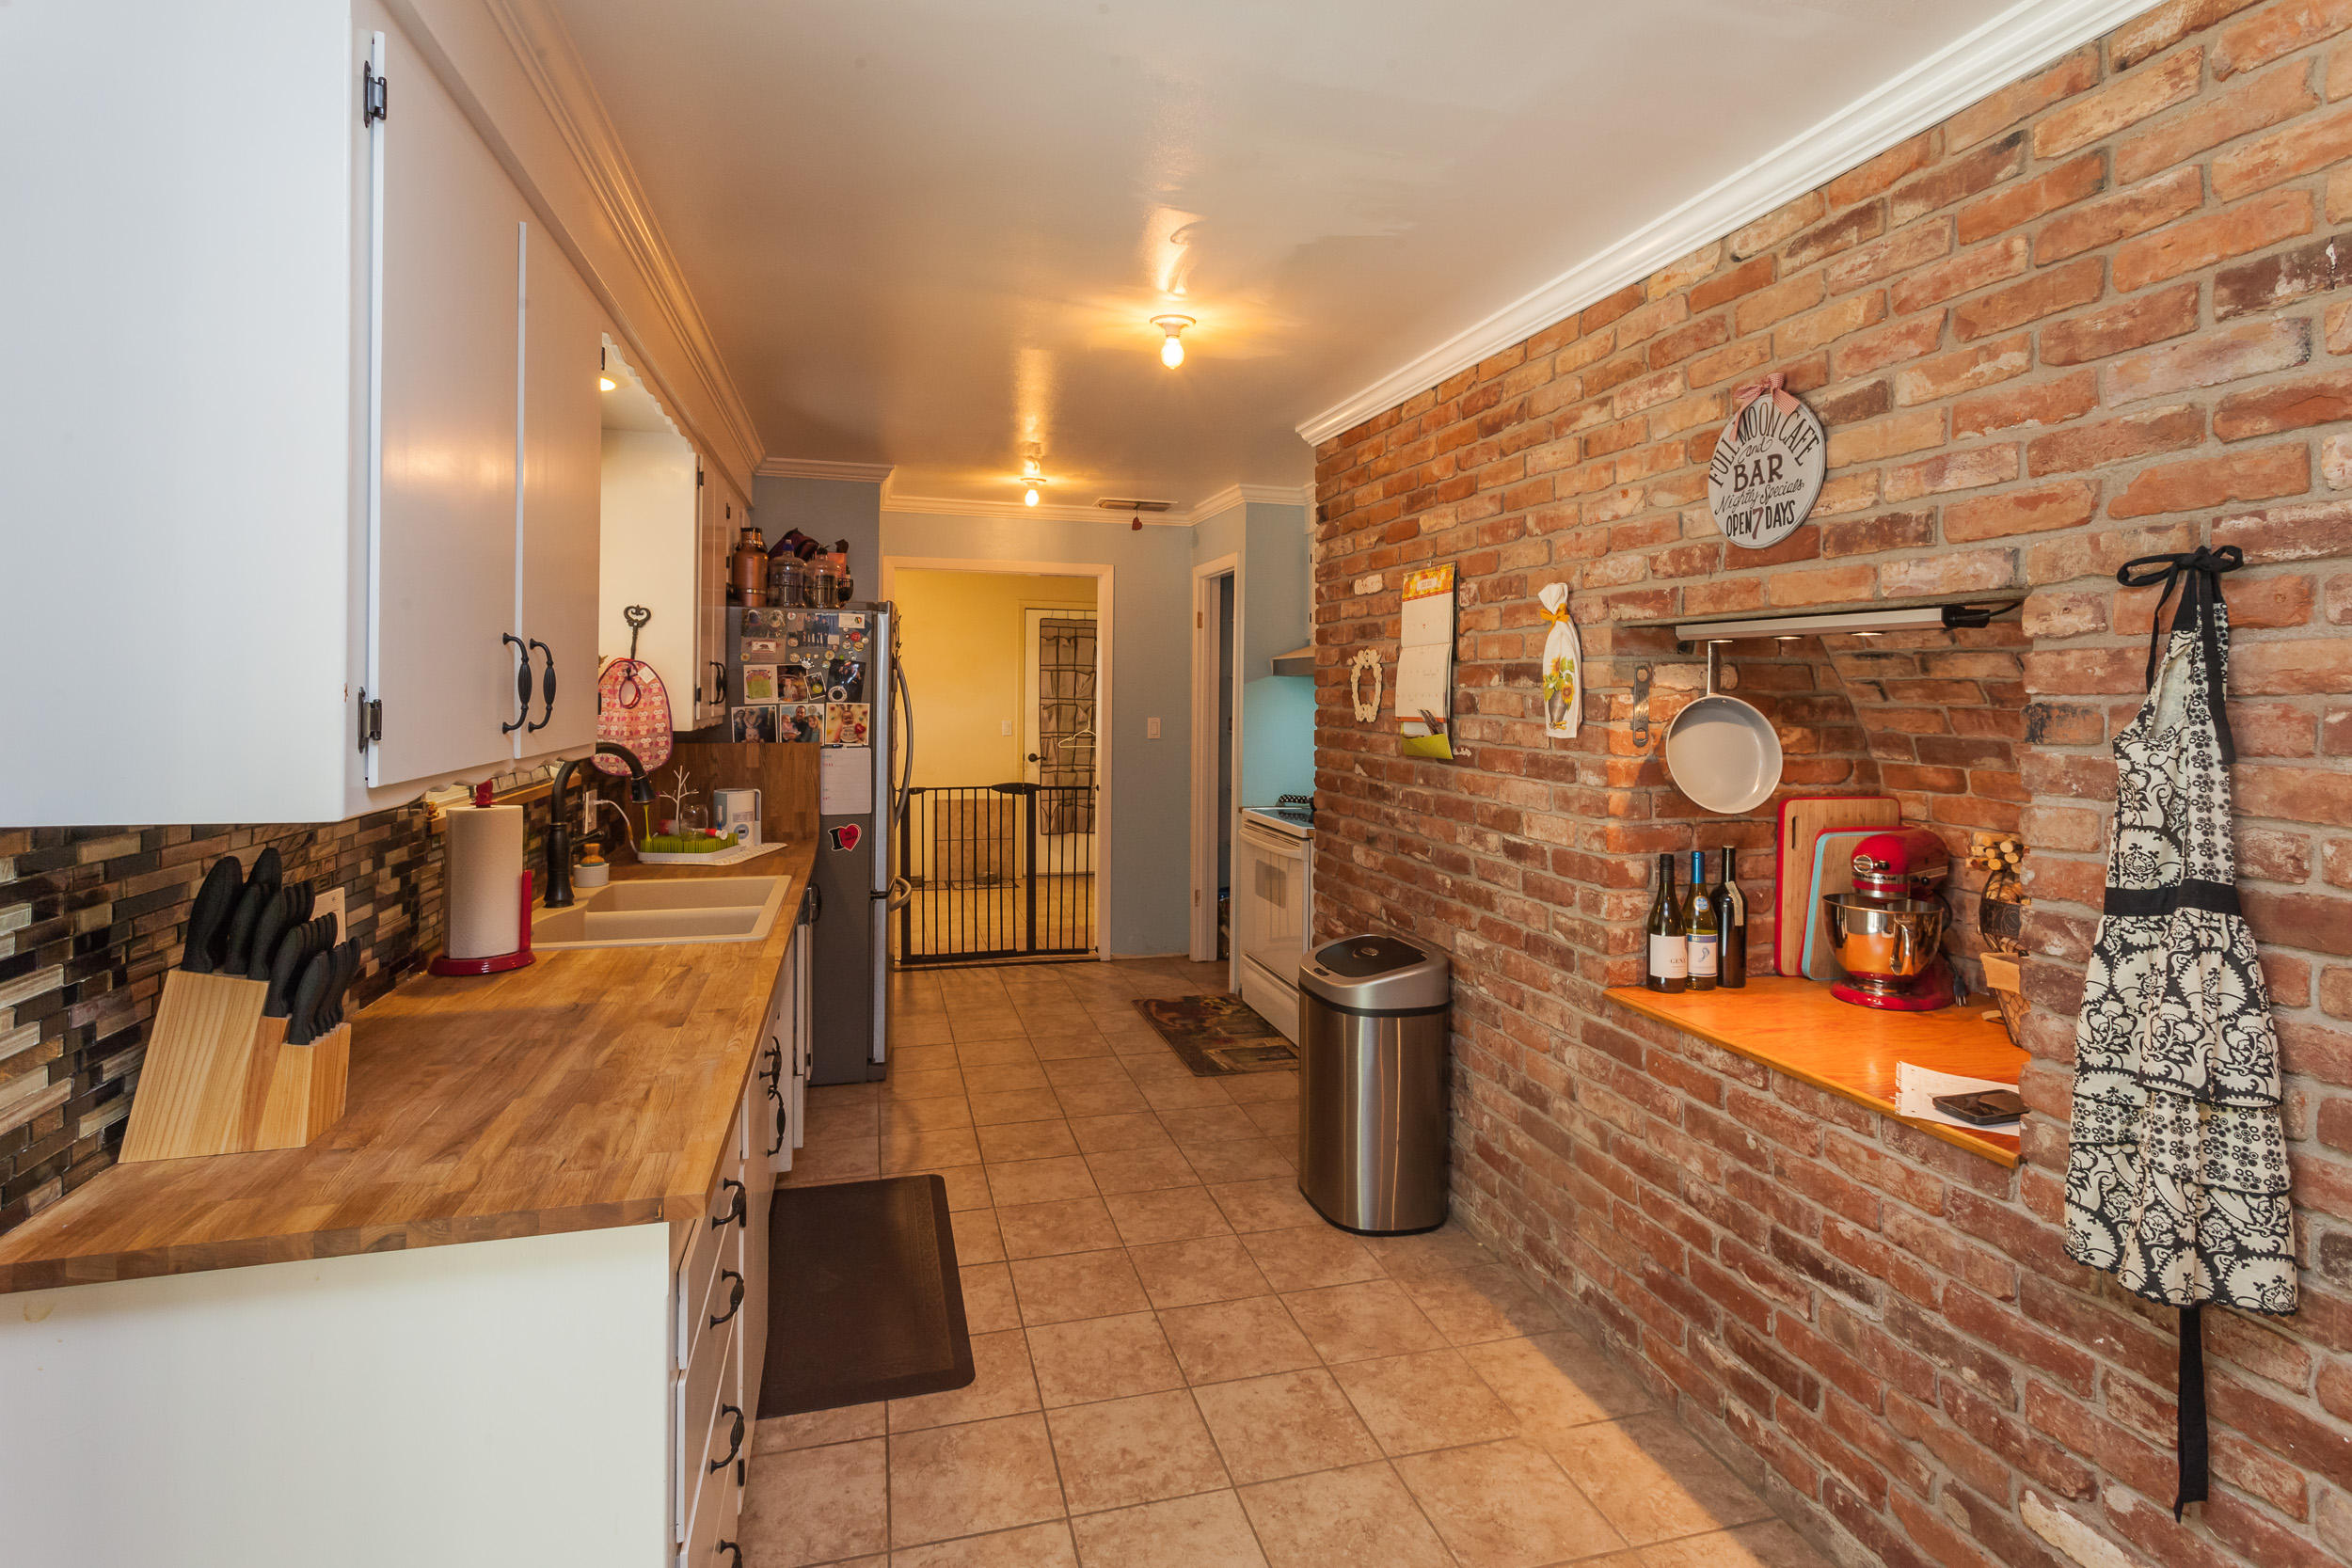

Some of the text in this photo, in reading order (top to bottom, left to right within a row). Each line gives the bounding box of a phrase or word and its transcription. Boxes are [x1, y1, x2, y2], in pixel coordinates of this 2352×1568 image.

[1708, 402, 1820, 488] FULL MOON CAFE
[1738, 436, 1773, 464] and
[1733, 453, 1784, 493] BAR
[1714, 488, 1760, 515] Nightly
[1725, 499, 1796, 540] OPEN 7 DAYS
